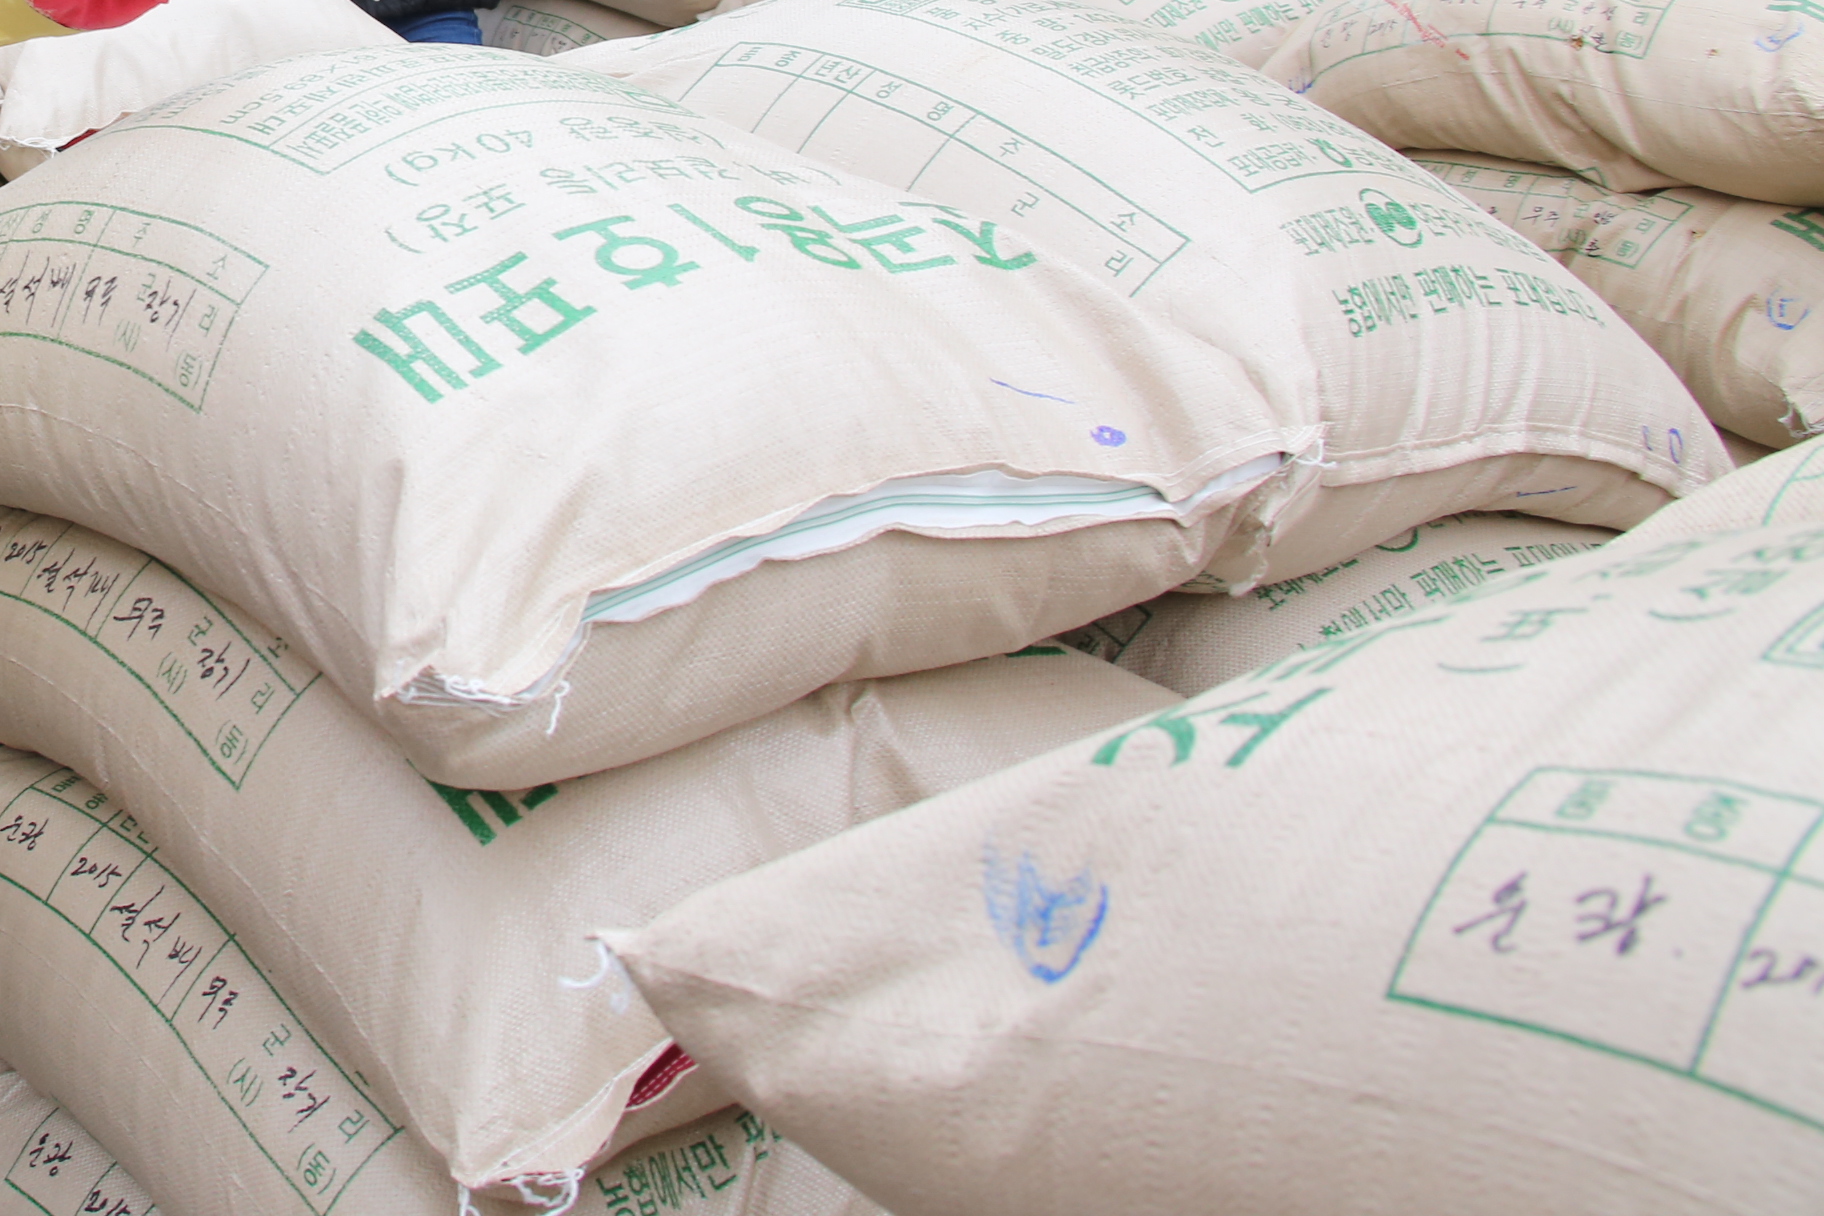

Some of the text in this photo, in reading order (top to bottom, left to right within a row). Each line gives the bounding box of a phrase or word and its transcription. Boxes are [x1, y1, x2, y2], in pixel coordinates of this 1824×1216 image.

[815, 57, 862, 85] 년산
[875, 81, 904, 101] 성
[926, 100, 956, 122] 명
[999, 137, 1027, 160] 주
[1109, 209, 1142, 233] 소
[1011, 191, 1135, 279] 군 리
[1333, 273, 1420, 338] 농협에서만
[5, 541, 49, 566] 2015
[188, 616, 213, 647] 군
[157, 652, 189, 695] (시)
[251, 682, 276, 715] 리
[214, 718, 249, 766] (동)
[70, 856, 123, 889] 2015
[262, 1023, 293, 1057] 군
[226, 1056, 264, 1108] (시)
[337, 1108, 371, 1146] 리
[296, 1143, 337, 1196] (동)
